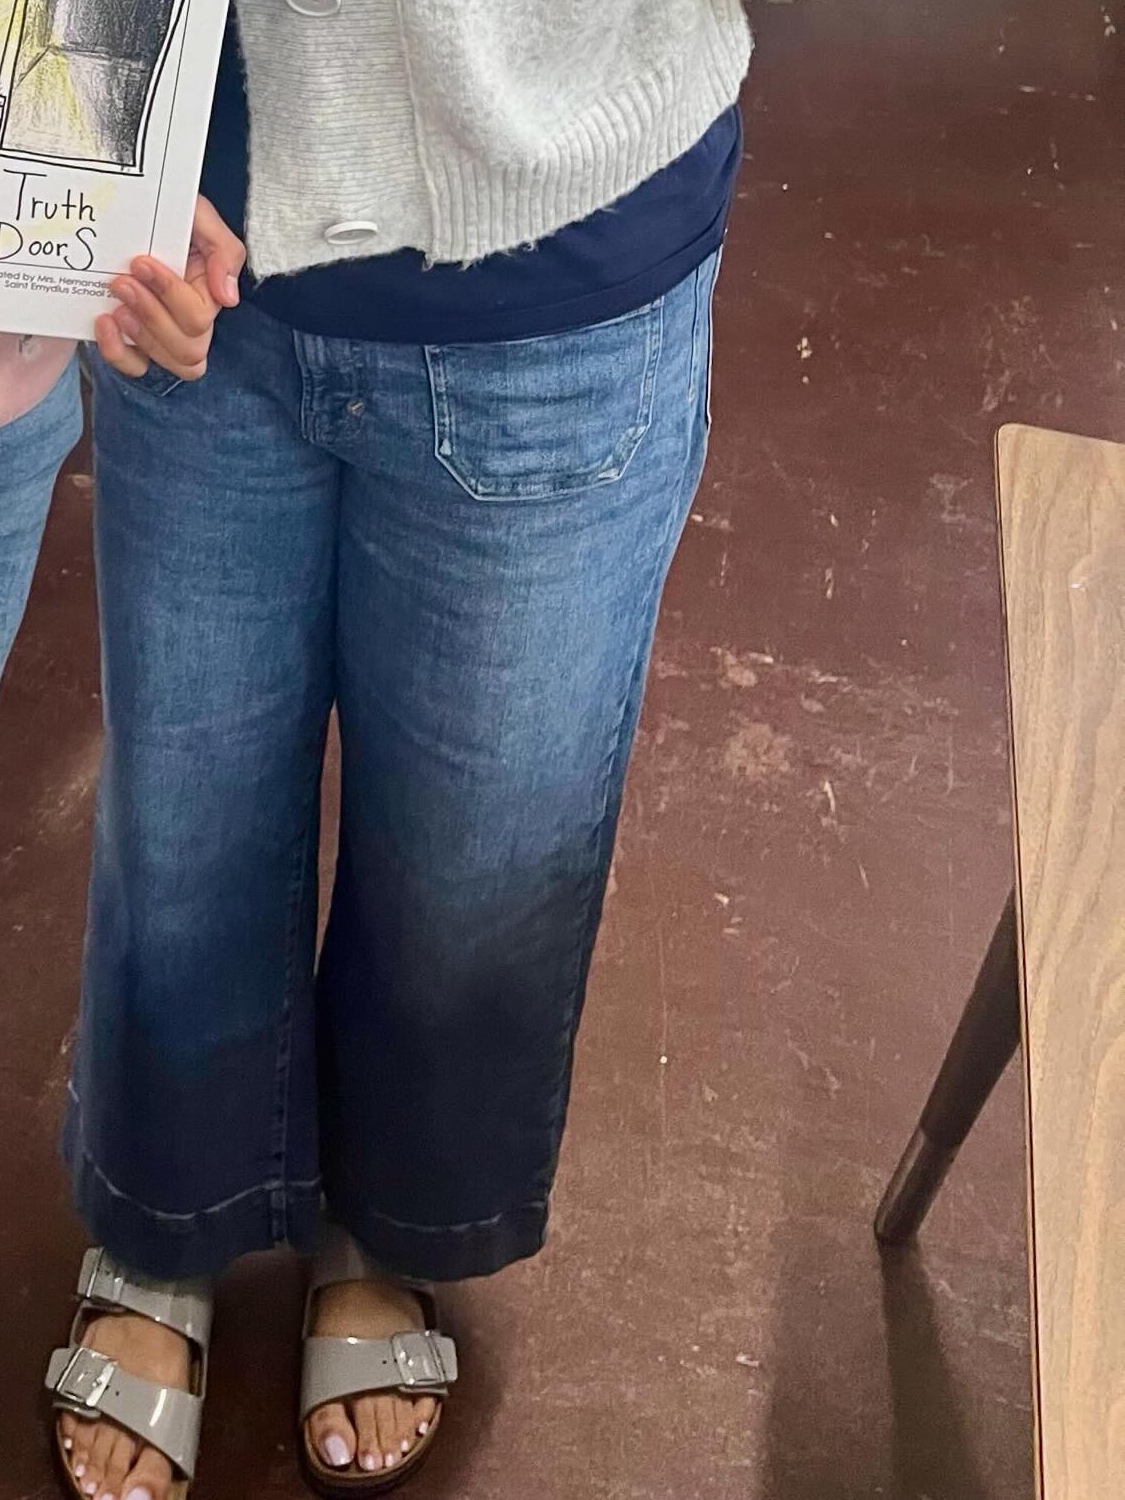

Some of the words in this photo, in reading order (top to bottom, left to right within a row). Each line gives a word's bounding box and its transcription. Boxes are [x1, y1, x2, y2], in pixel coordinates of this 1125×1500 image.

[3, 169, 97, 221] Truth
[4, 280, 29, 290] Saint
[72, 286, 106, 297] School
[22, 272, 35, 282] by
[37, 274, 55, 284] Mrs.
[59, 277, 110, 289] Hernande
